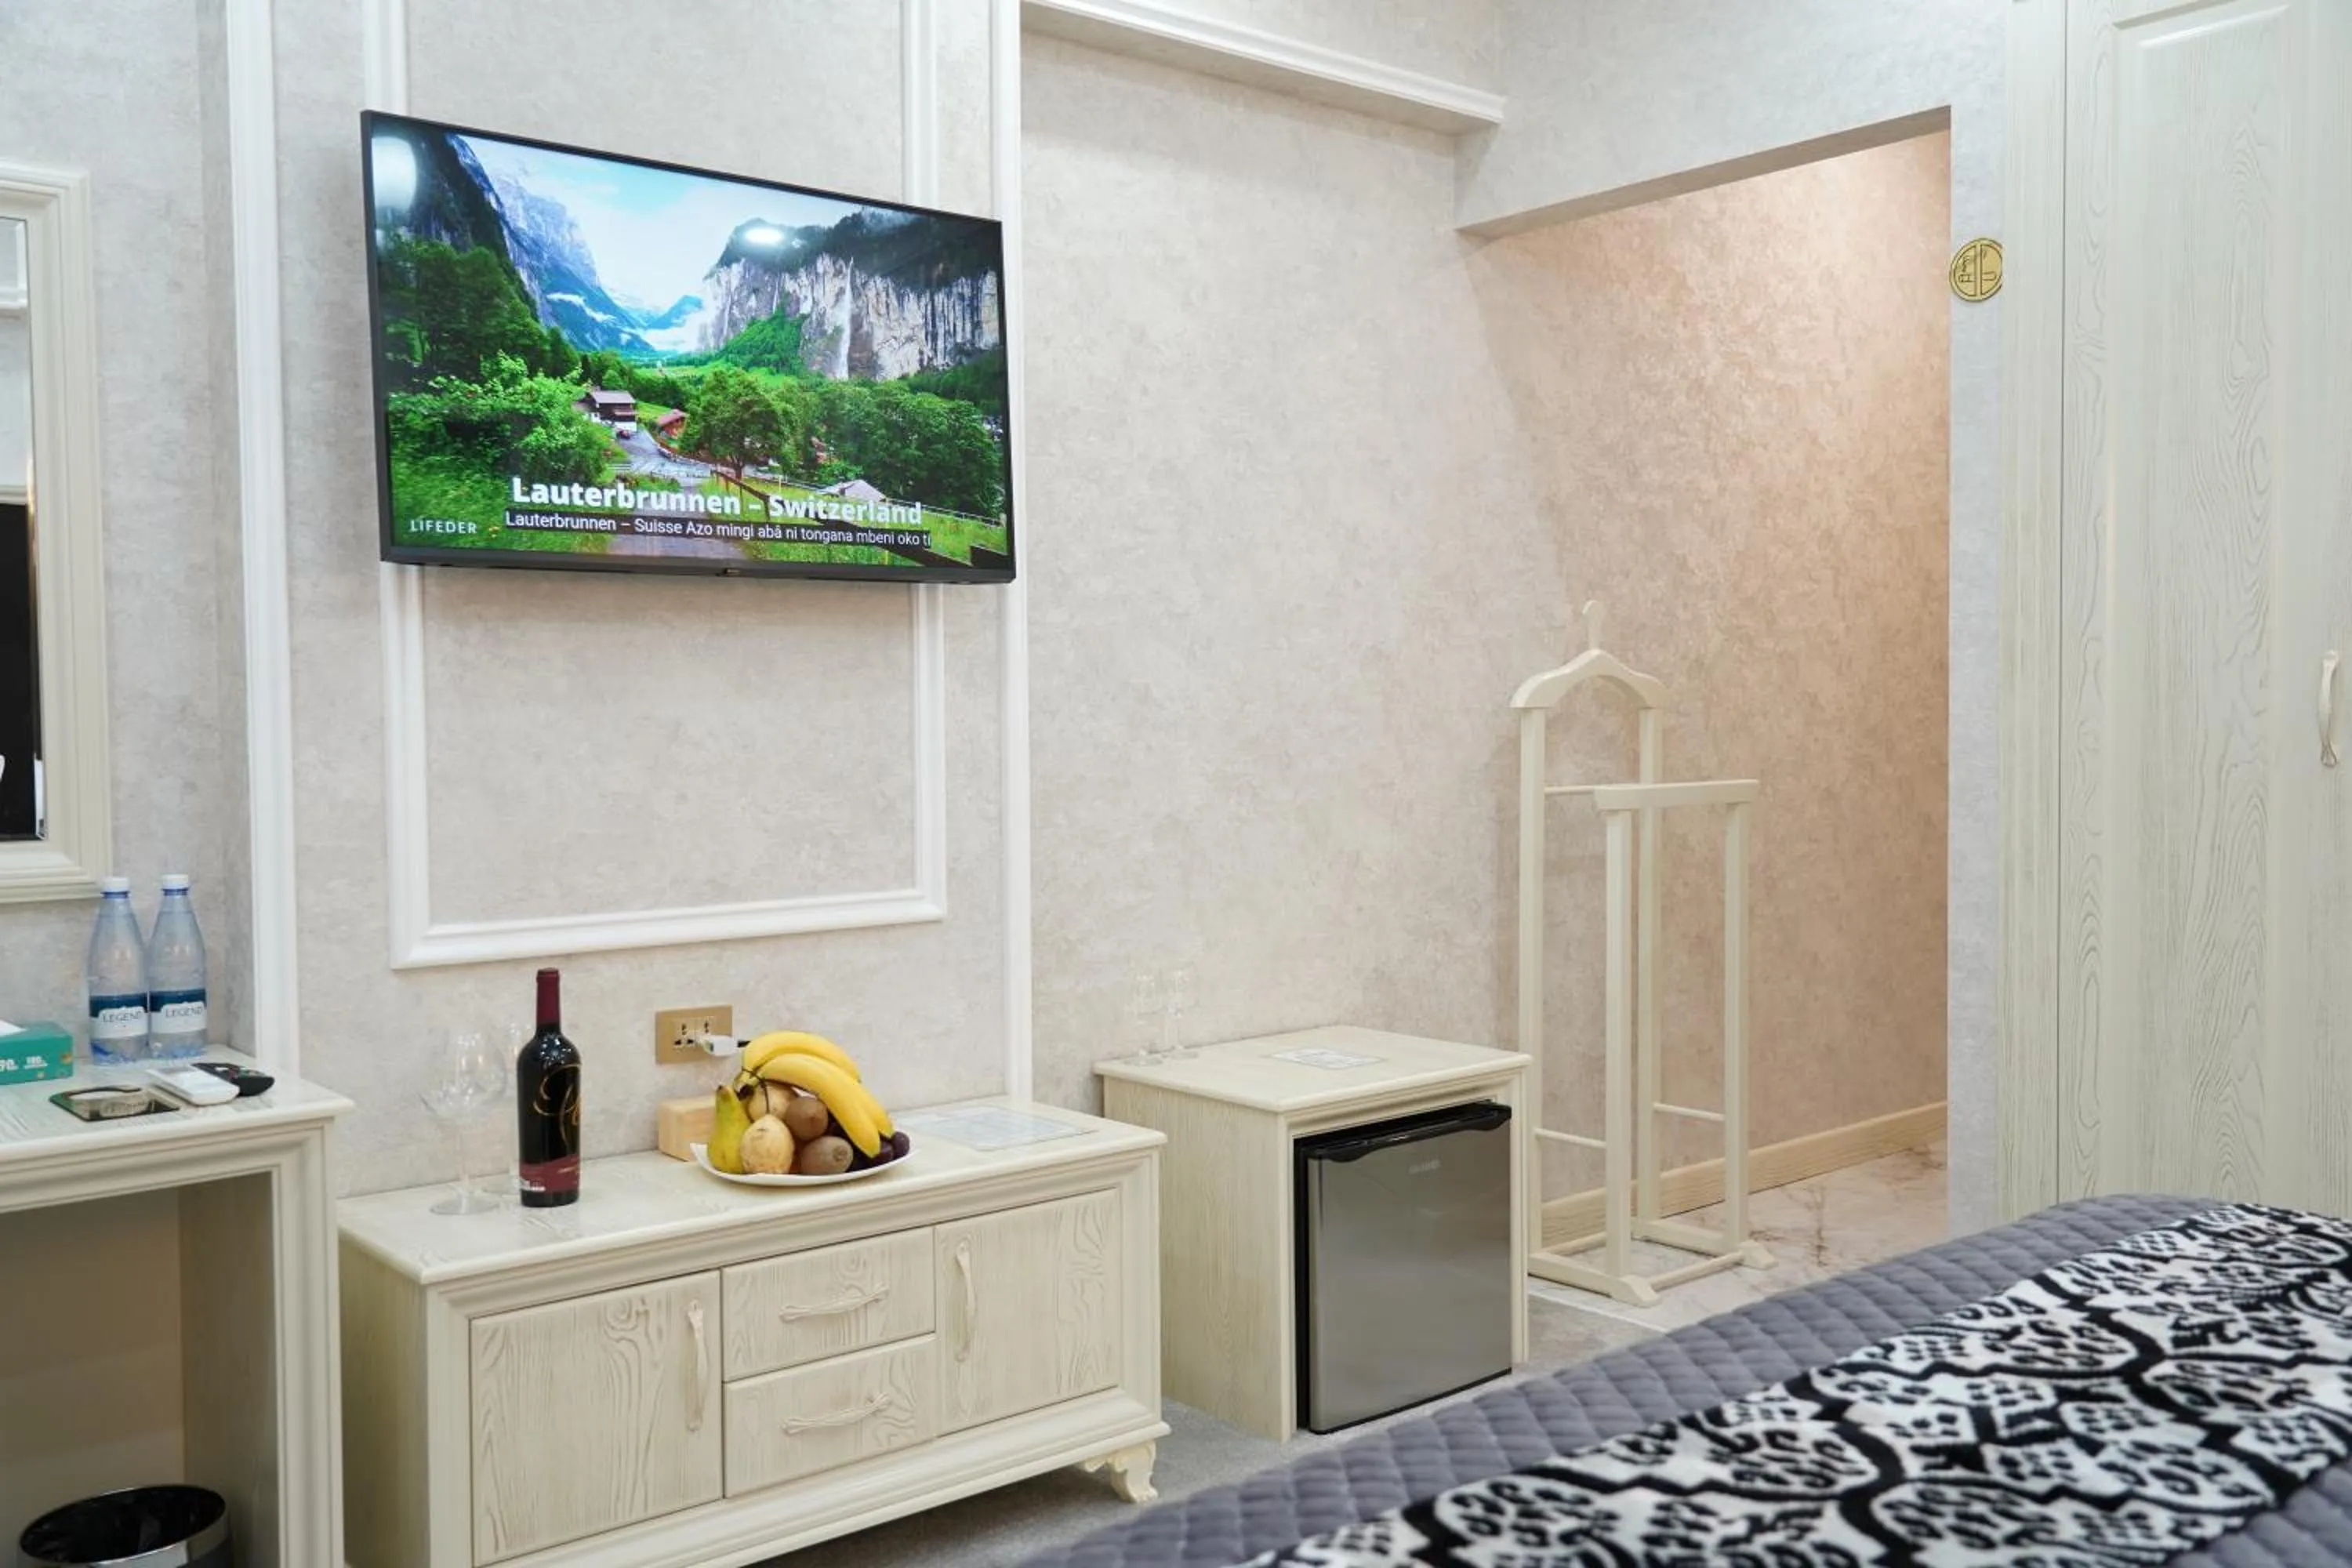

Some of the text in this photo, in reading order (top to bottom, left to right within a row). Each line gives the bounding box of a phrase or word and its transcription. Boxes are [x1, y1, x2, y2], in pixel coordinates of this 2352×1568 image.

[512, 477, 740, 515] Lauterbrunnen
[769, 494, 922, 524] Switzerland
[409, 519, 477, 534] LIFEDER
[506, 511, 616, 531] Lauterbrunnen
[634, 518, 682, 534] Suisse
[686, 521, 713, 535] Azo
[717, 523, 754, 540] mingi
[786, 526, 797, 540] ni
[801, 528, 853, 545] tongana
[856, 529, 895, 544] mbeni
[898, 532, 920, 546] oko
